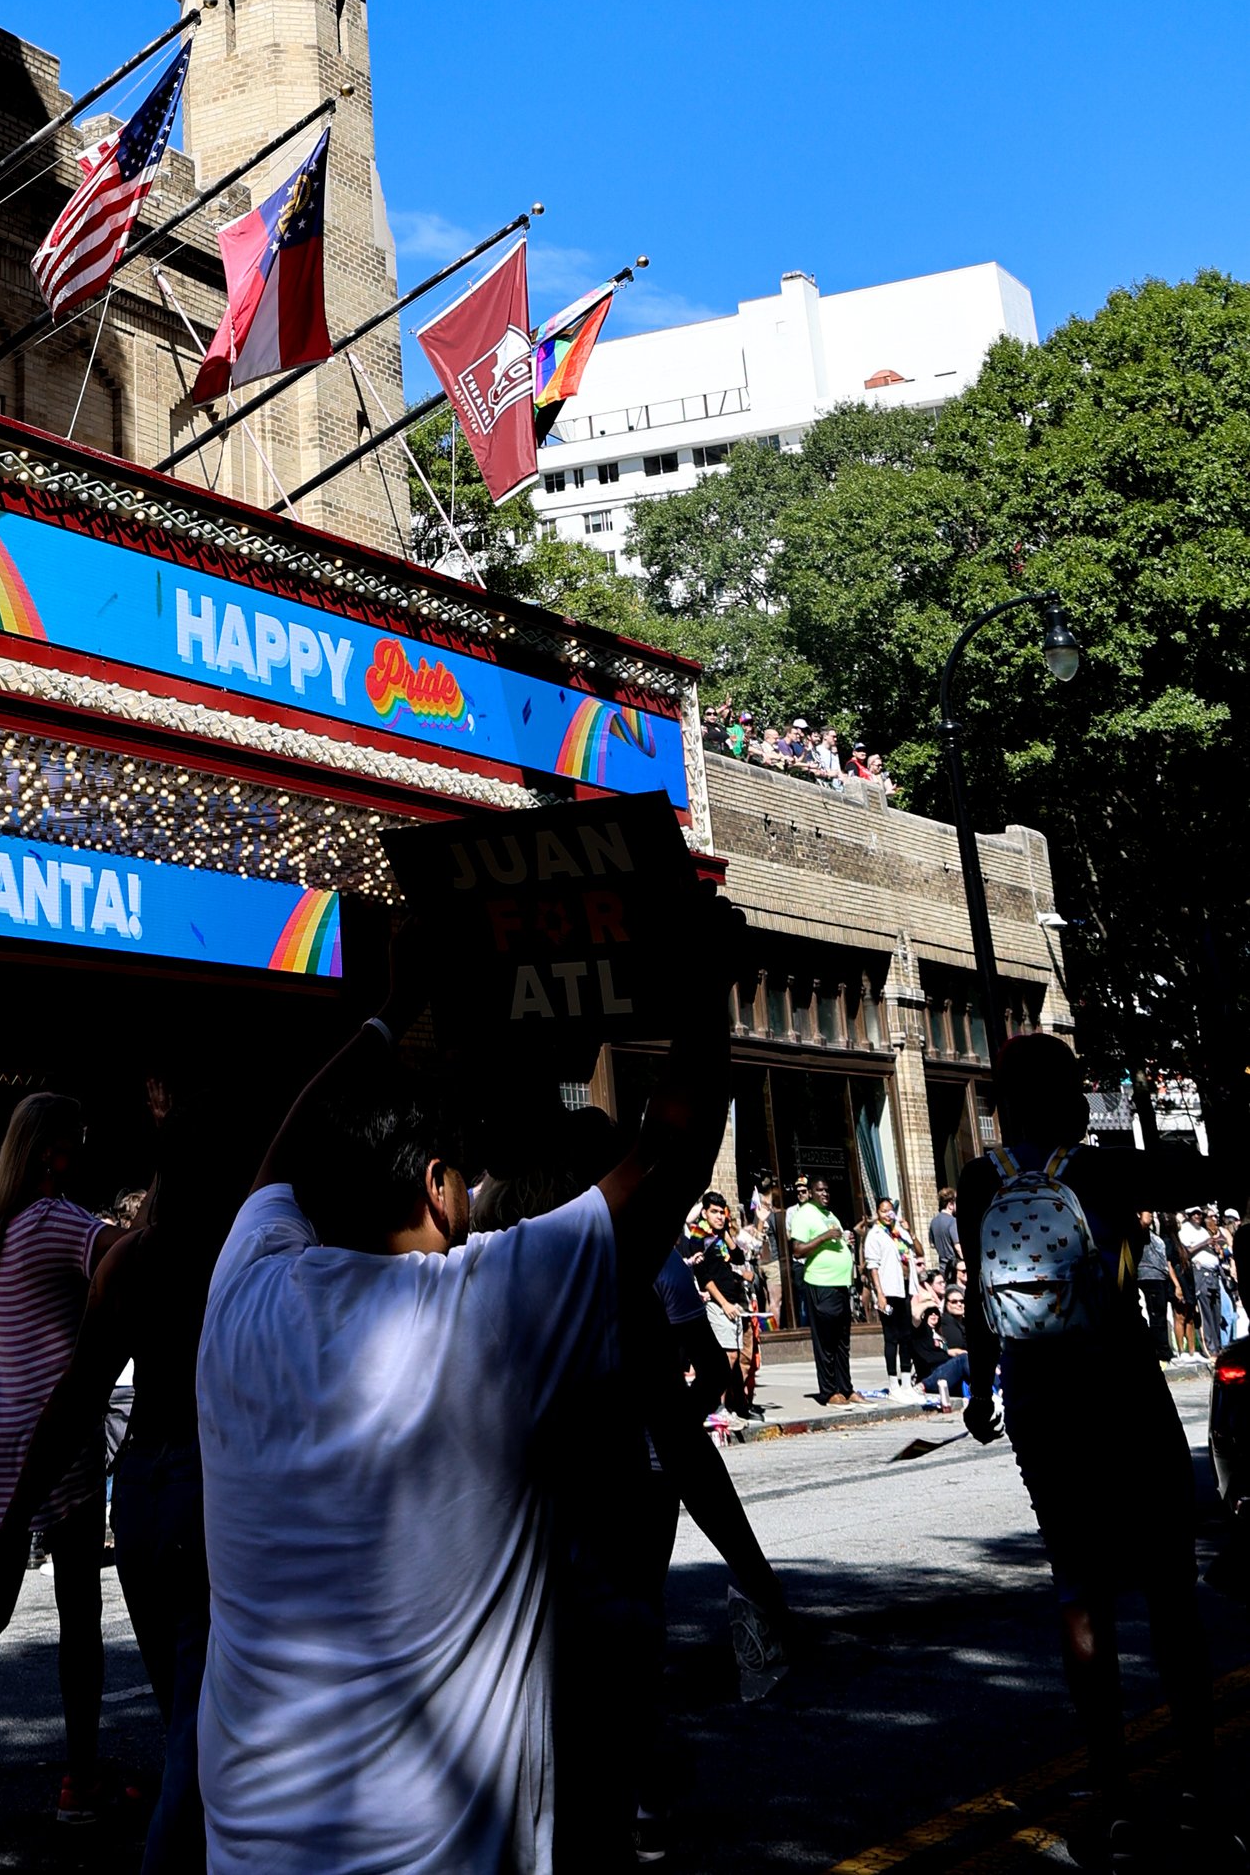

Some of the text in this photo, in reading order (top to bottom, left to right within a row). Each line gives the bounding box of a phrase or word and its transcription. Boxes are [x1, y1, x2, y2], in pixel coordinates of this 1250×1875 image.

[465, 374, 492, 425] THEATRE
[176, 588, 354, 705] HAPPY
[449, 822, 636, 890] JUAN
[483, 888, 633, 954] FOR
[510, 959, 634, 1021] ATL
